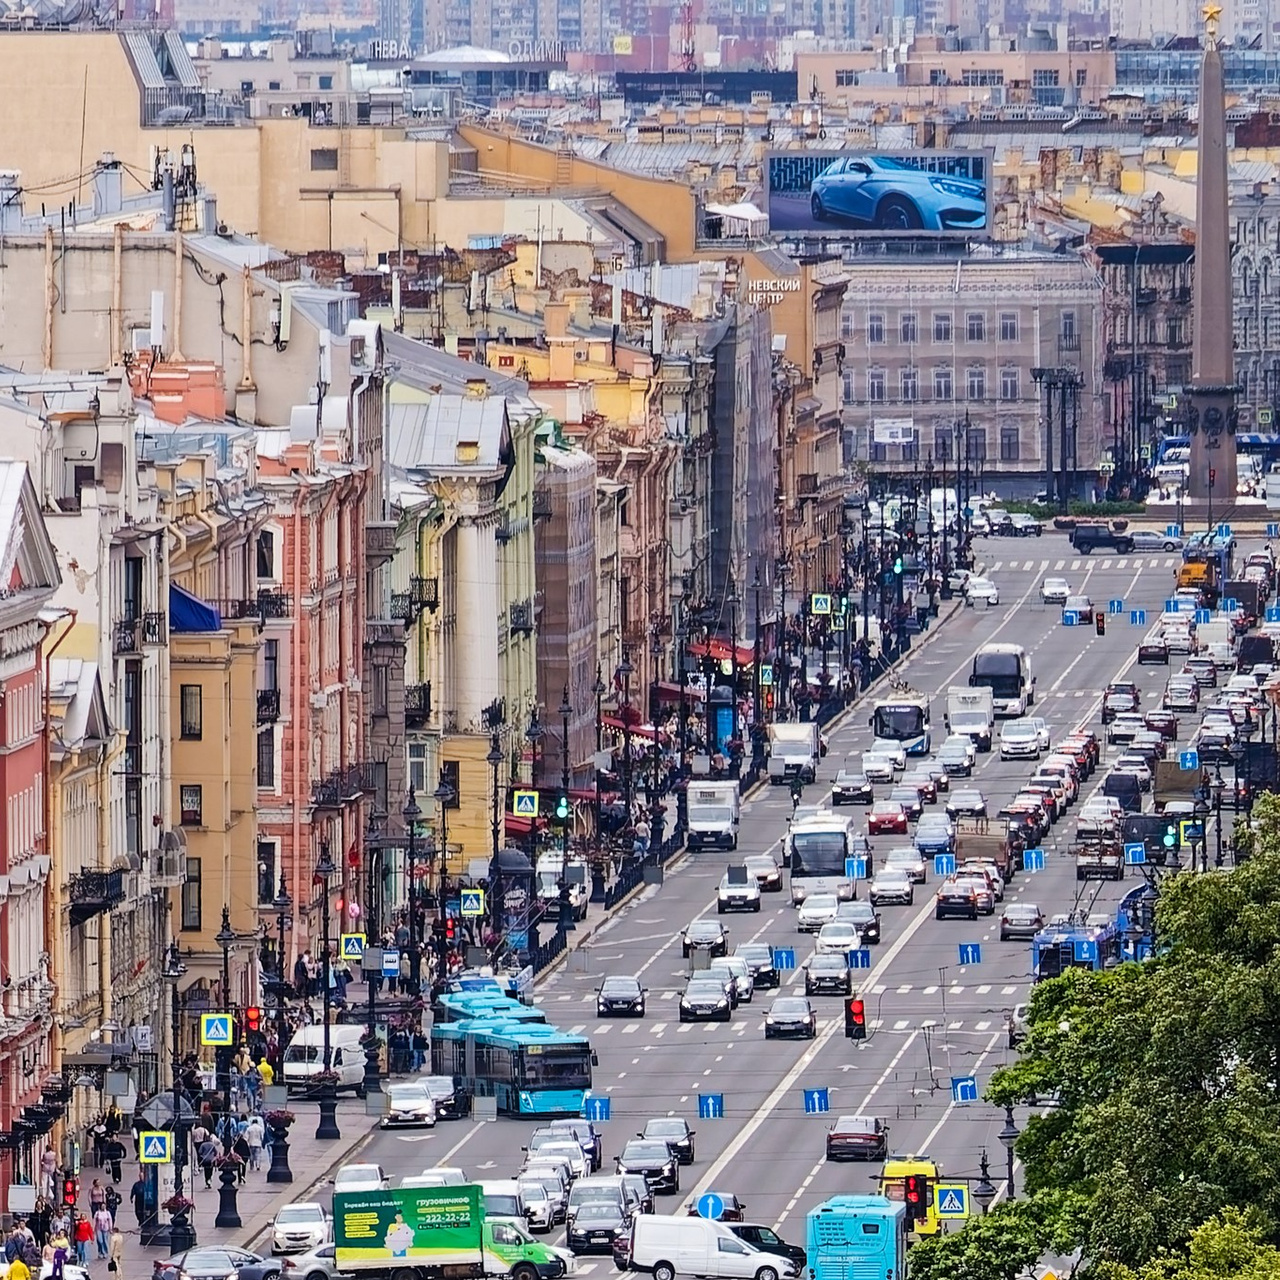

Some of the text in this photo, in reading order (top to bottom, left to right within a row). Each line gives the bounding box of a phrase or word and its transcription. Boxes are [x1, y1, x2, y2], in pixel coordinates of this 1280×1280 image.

[748, 279, 800, 291] НЕВСКИЙ
[417, 1197, 470, 1207] грузовичкоф
[426, 1213, 471, 1223] 222-22-22
